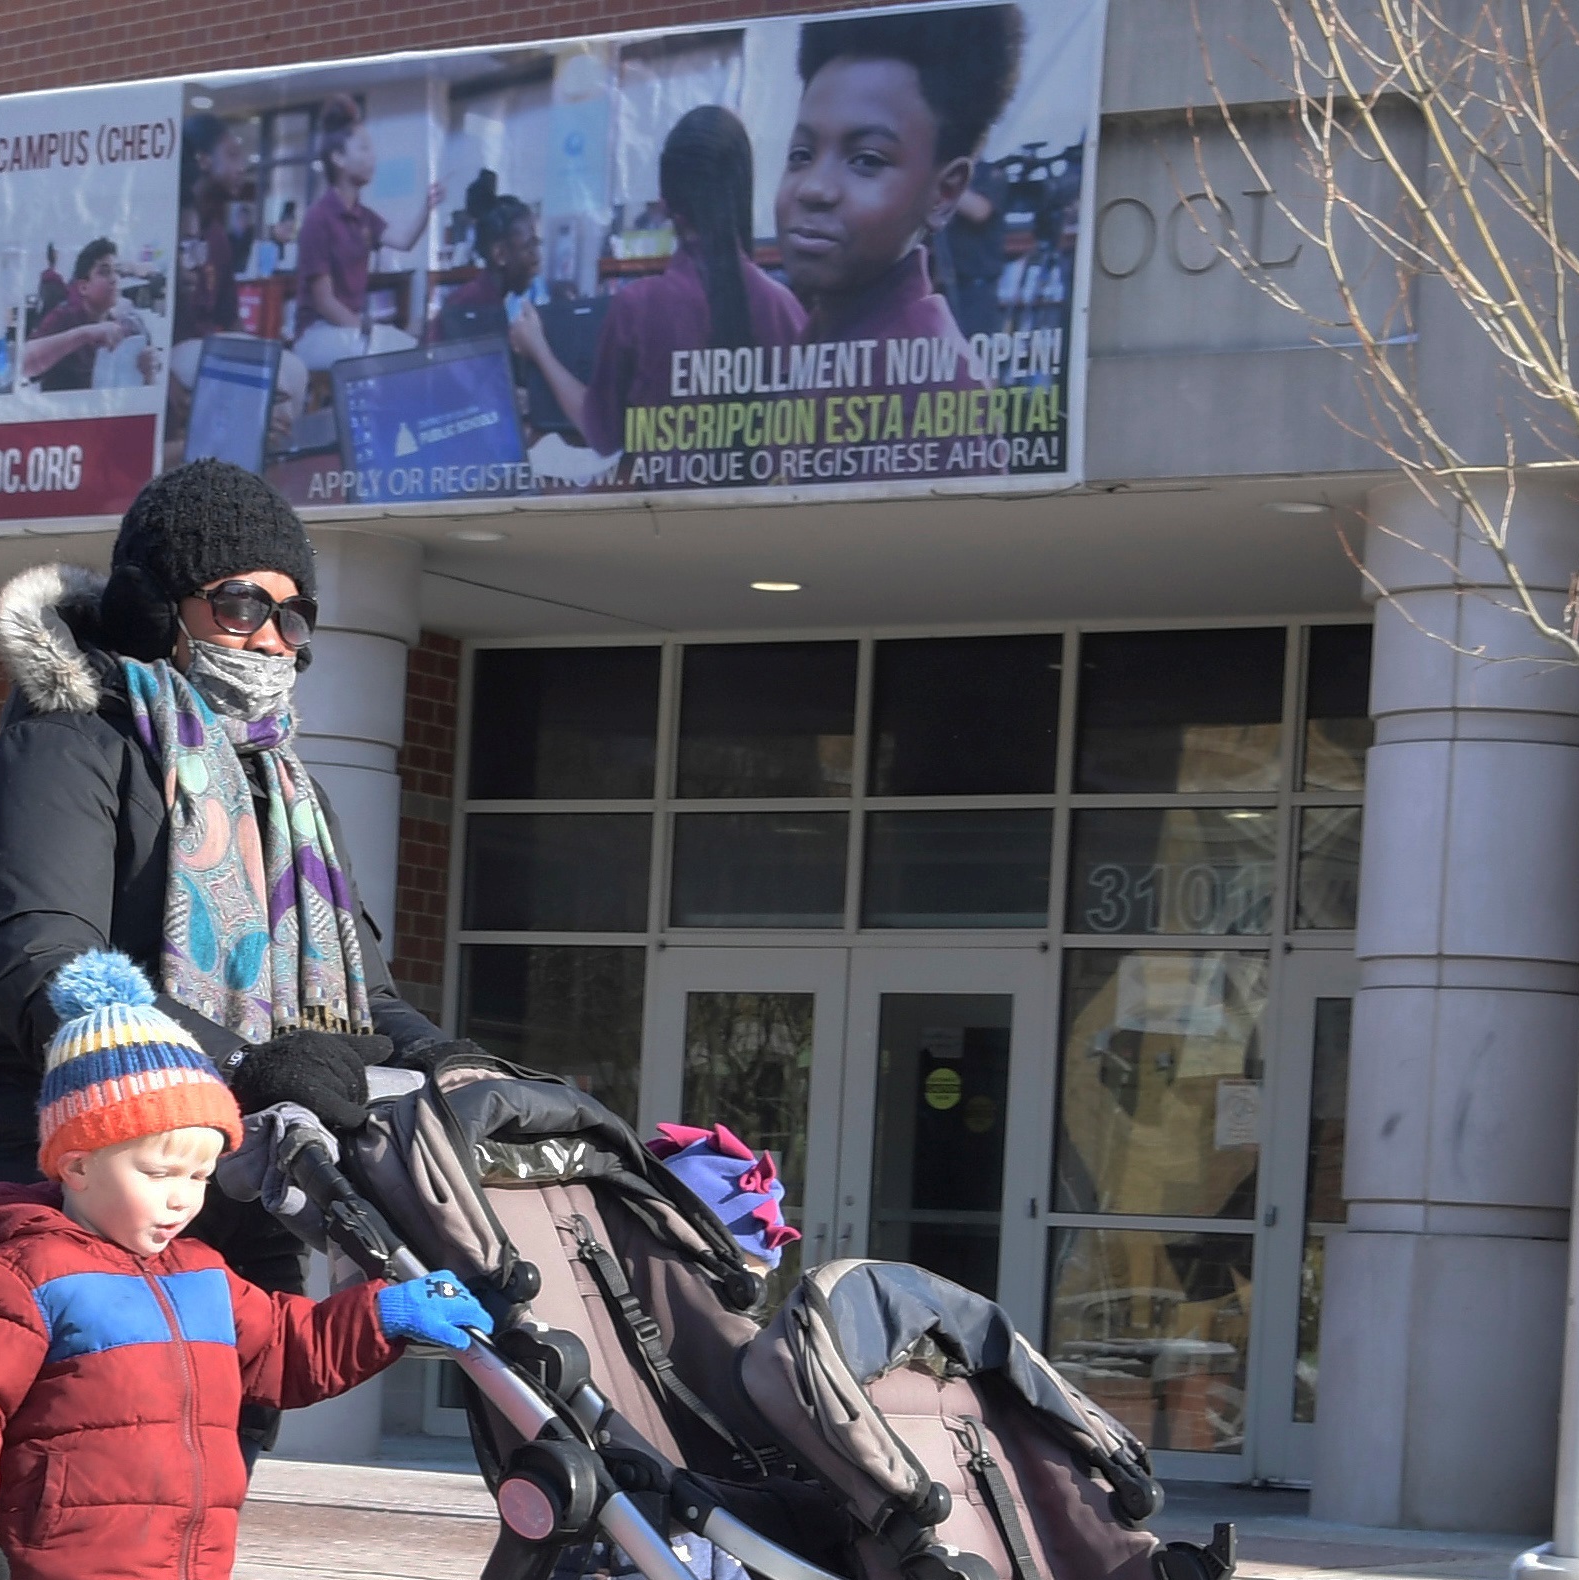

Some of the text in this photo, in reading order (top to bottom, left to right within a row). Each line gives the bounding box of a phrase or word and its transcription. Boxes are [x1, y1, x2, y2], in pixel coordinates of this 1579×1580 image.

[96, 118, 177, 165] (CHEC)
[670, 328, 1062, 397] ENROLLMENT NOW OPEN!
[625, 384, 1060, 453] INSCRIPCION ESTA ABIERTA!
[308, 468, 382, 499] APPLY
[388, 466, 424, 496] OR
[630, 451, 744, 486] APLIQUE
[750, 449, 773, 480] O
[781, 441, 940, 478] REGISTRESE
[946, 437, 1060, 472] AHORA!
[1086, 863, 1261, 934] 3101
